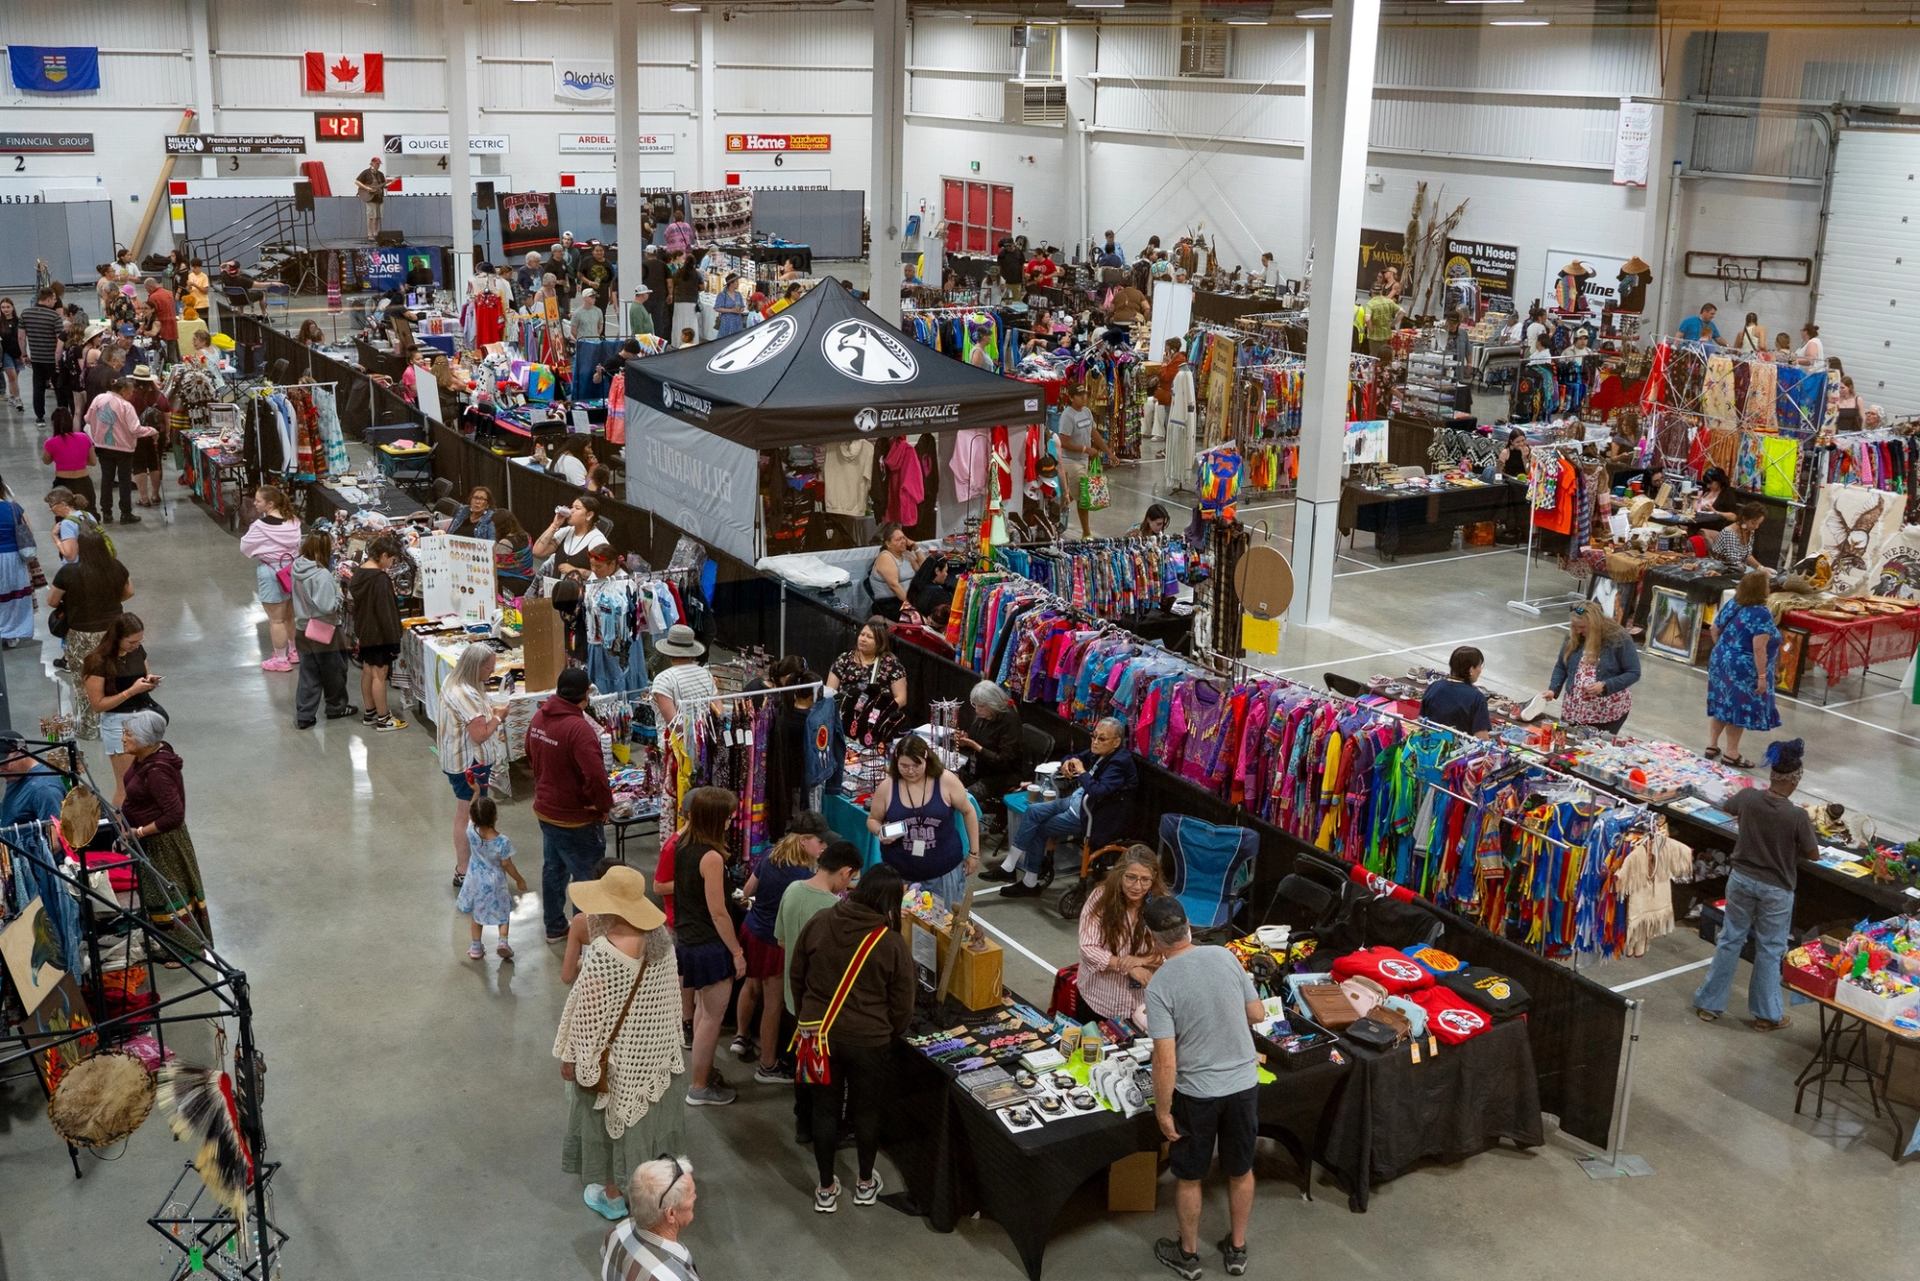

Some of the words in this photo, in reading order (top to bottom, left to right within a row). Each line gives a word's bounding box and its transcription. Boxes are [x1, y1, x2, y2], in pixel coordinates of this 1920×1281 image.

[6, 137, 53, 146] FINANCIAL
[58, 137, 90, 146] GROUP
[207, 136, 238, 144] Premium
[239, 136, 254, 144] Fuel
[269, 136, 303, 144] Lubricants
[408, 140, 449, 149] QUIGLE
[469, 140, 504, 149] ECTRIC
[578, 136, 610, 144] ARDIEL
[747, 136, 786, 149] Home
[15, 156, 25, 171] 2
[229, 156, 239, 171] 3
[437, 155, 447, 170] 4
[774, 153, 783, 167] 6
[1372, 250, 1404, 264] MAVER
[1449, 241, 1474, 254] Guns
[1475, 244, 1483, 256] N
[1485, 246, 1517, 260] Hoses
[369, 263, 401, 274] STAGE
[1491, 260, 1515, 270] Exteriors
[1580, 280, 1615, 297] dline
[672, 388, 712, 415] BILLWARDLIFE
[880, 403, 961, 422] BILLWARDLIFE
